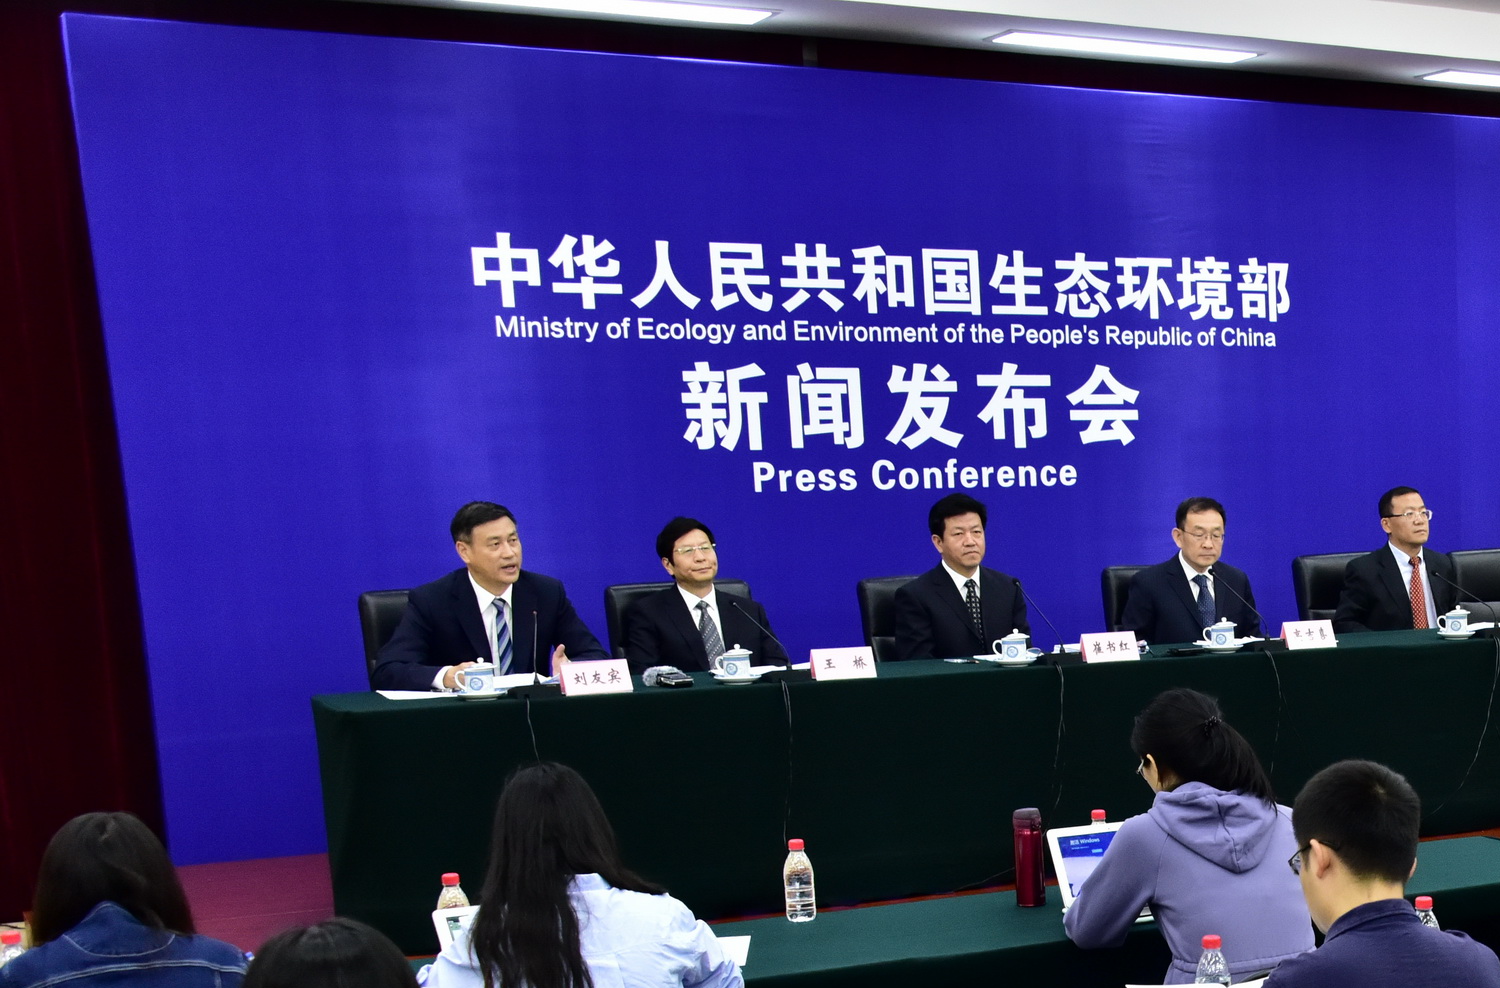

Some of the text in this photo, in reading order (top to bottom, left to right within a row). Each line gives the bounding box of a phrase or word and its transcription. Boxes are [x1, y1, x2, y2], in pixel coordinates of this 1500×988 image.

[471, 232, 1290, 322] 中华人民共和国生态环境部
[495, 315, 1277, 348] Ministry of Ecology and Environment of the People's Republic of China
[681, 362, 1139, 451] 新闻发布会
[753, 459, 1077, 492] Press Conference
[1092, 639, 1131, 656] 崔书红
[573, 667, 622, 687] 刘友宾
